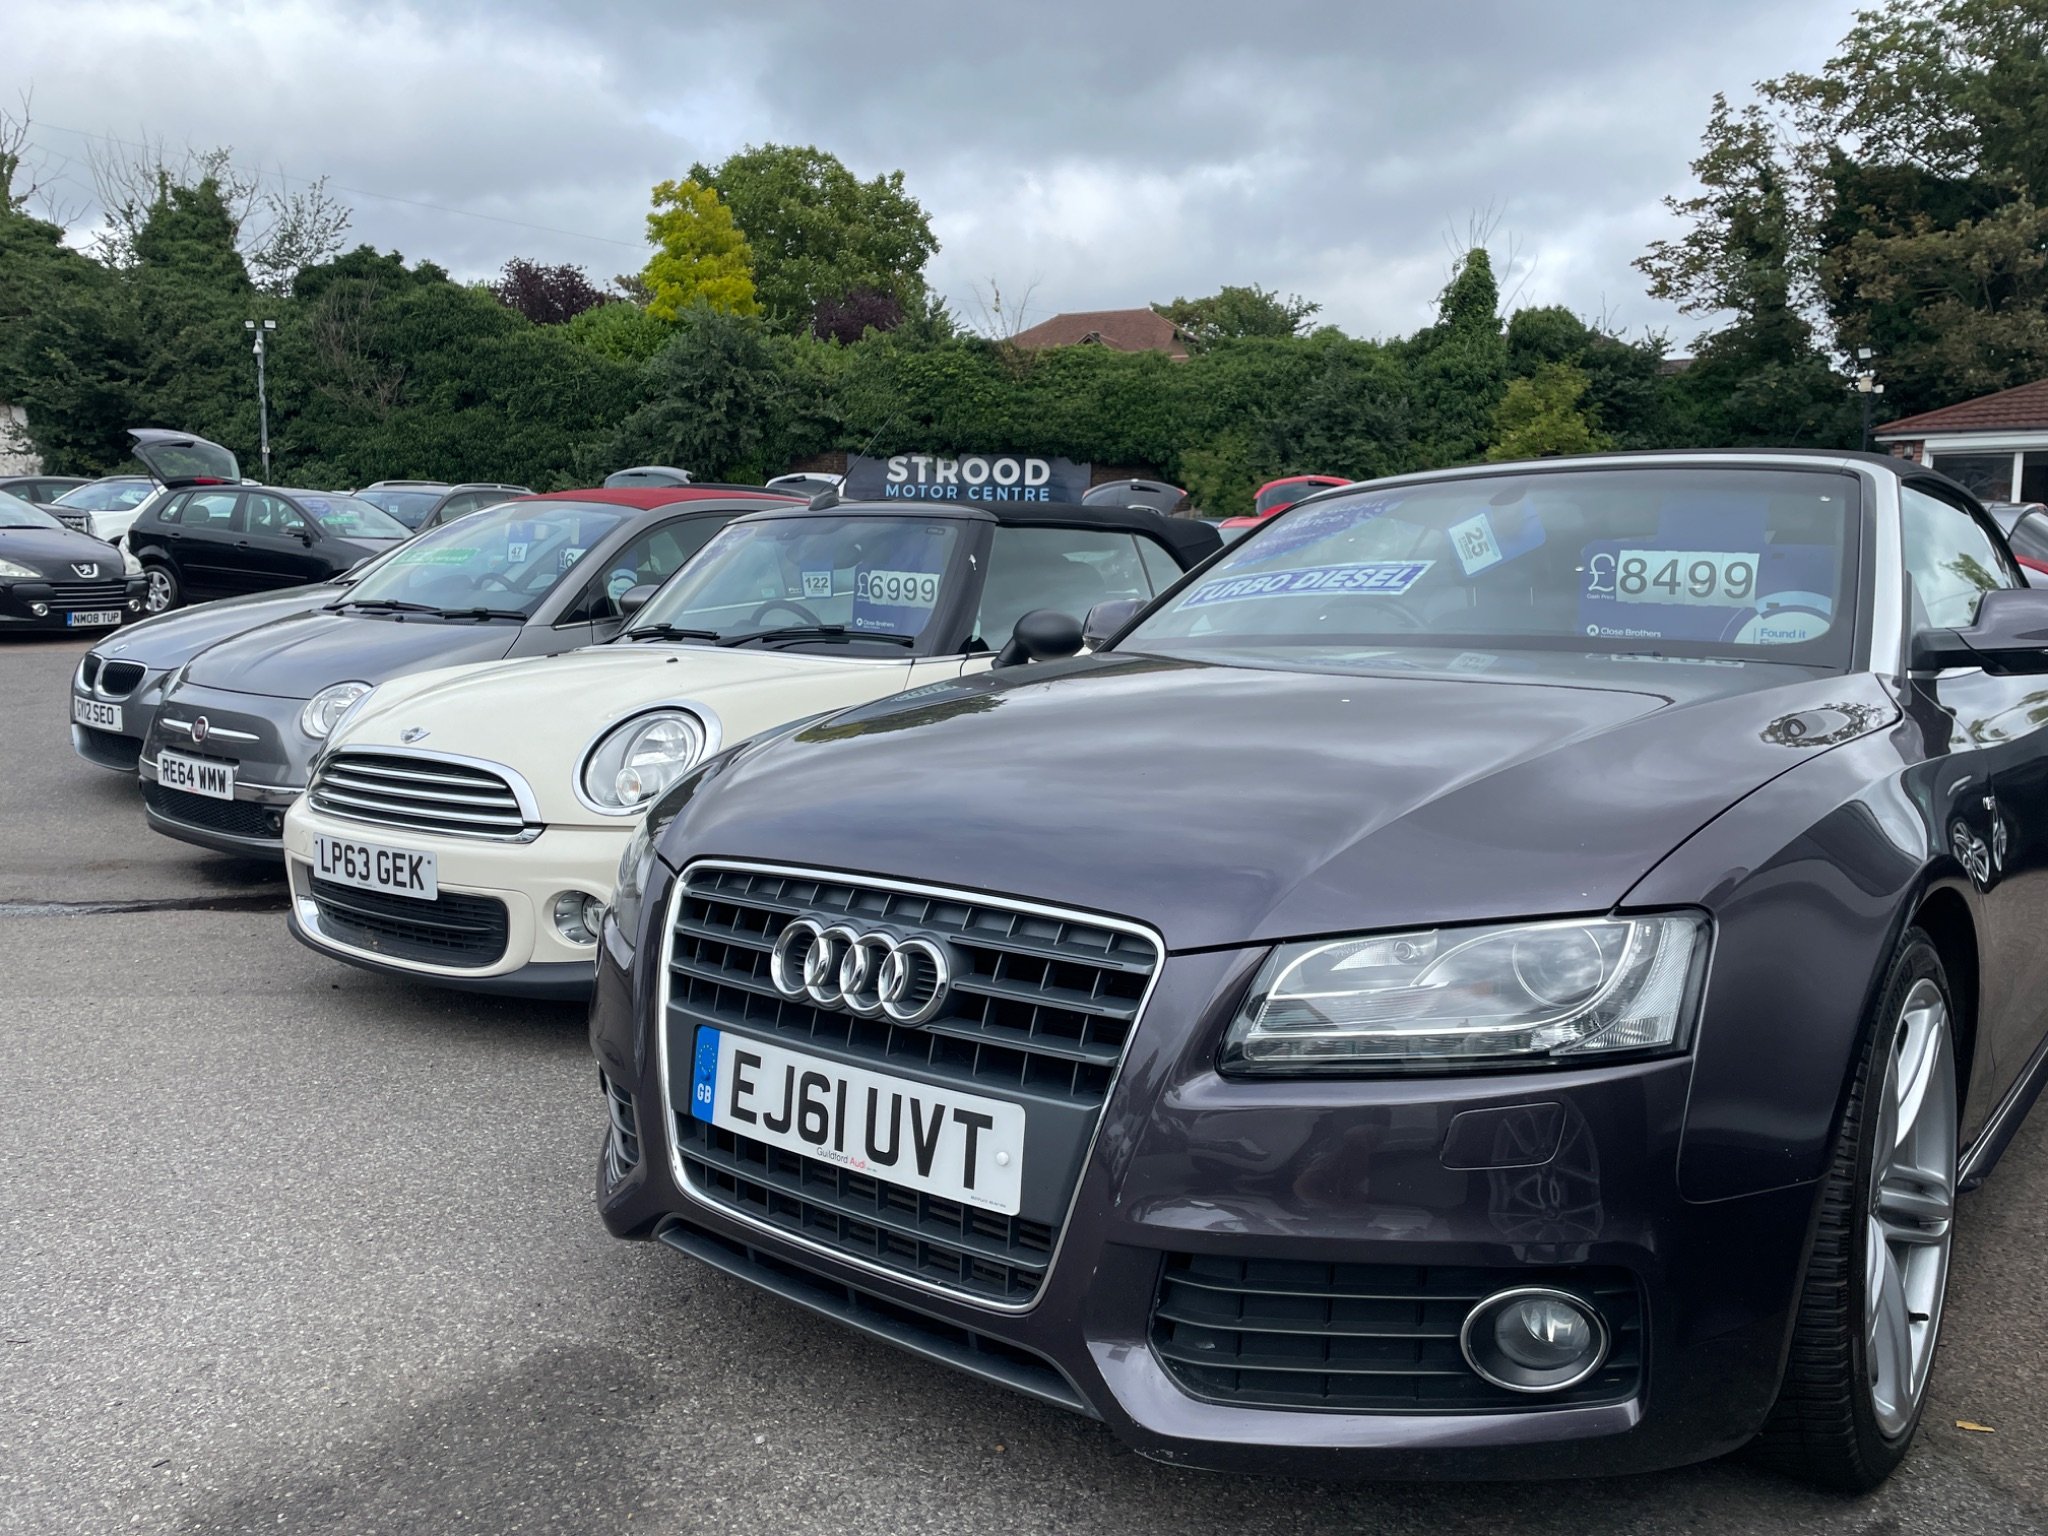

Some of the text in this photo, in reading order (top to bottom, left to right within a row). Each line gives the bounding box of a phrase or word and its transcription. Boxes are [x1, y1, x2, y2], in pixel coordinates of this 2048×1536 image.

[887, 456, 1050, 486] STROOD
[886, 484, 1050, 501] MOTOR CENTRE
[511, 547, 523, 556] 47
[1465, 527, 1490, 557] 25
[805, 576, 829, 589] 122
[1194, 567, 1410, 603] TURBO DIESEL
[1588, 553, 1753, 598] £8499
[857, 572, 936, 602] £6999
[73, 612, 119, 624] NM08 TUP
[1601, 627, 1624, 636] Close
[1625, 628, 1662, 638] Brothers
[1761, 628, 1807, 639] Found it
[93, 704, 114, 725] SEO
[162, 759, 226, 793] RE64 WMW
[321, 838, 424, 890] LP63 GEK
[697, 1083, 711, 1103] GB
[730, 1049, 993, 1190] EJ61 UVT
[816, 1147, 867, 1169] Guildford Audi
